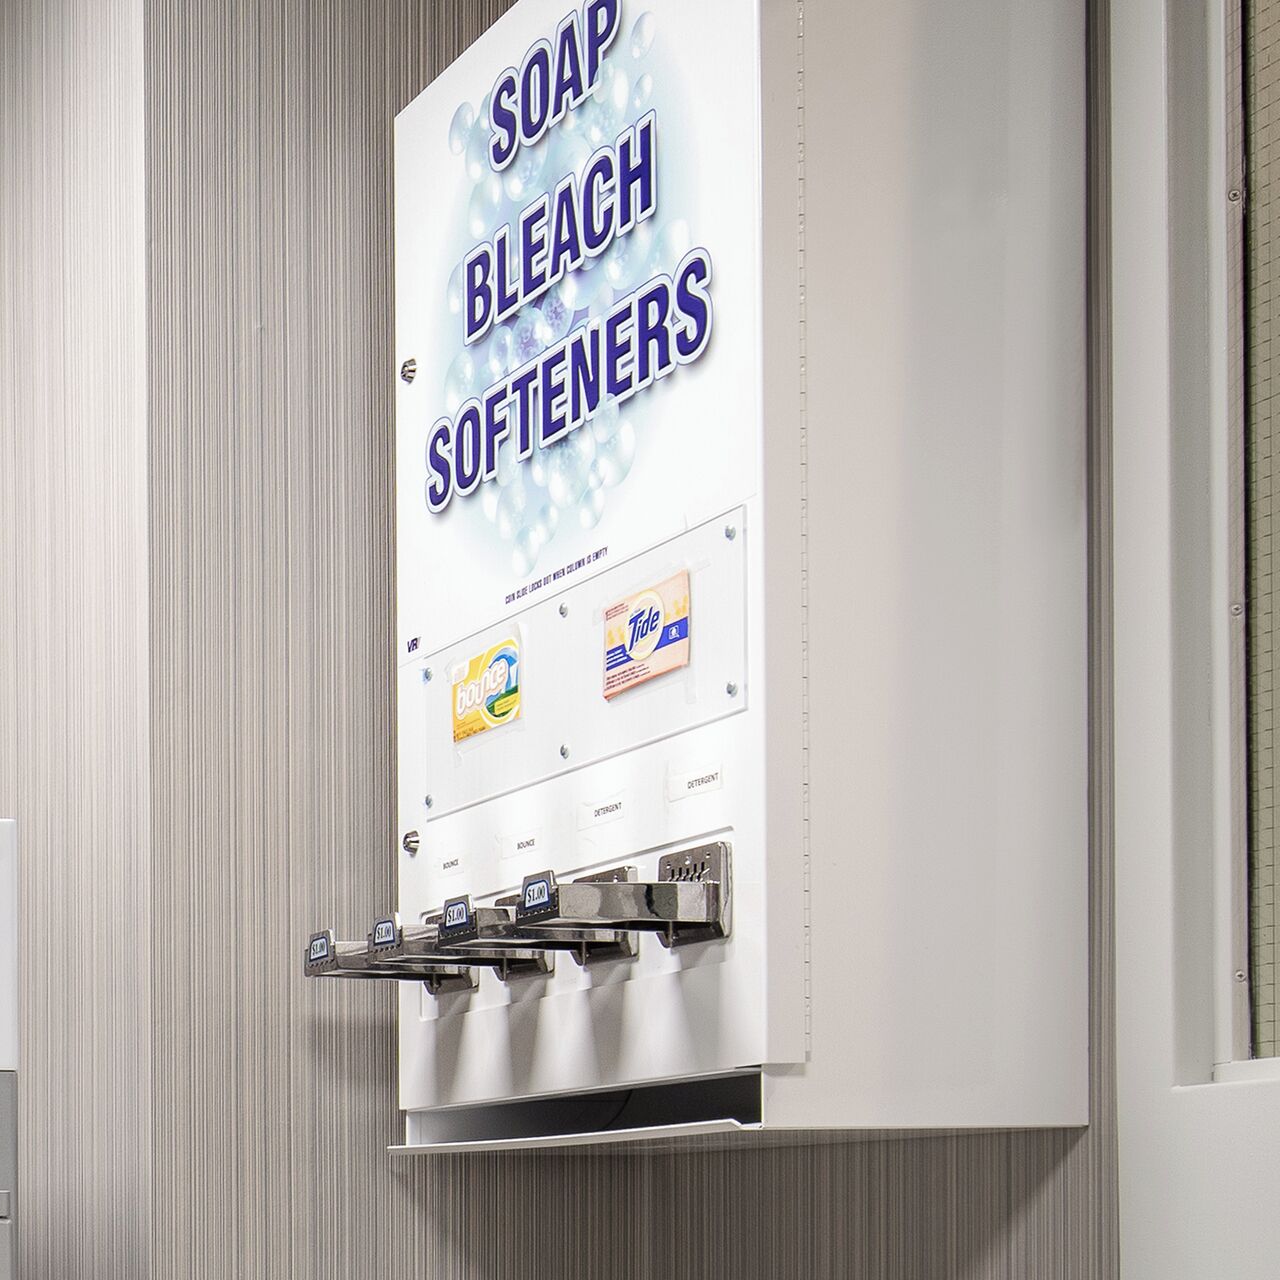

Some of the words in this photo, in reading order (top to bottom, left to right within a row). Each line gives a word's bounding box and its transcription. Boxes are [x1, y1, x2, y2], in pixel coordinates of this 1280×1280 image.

[491, 0, 621, 170] SOAP
[464, 112, 655, 344] BLEACH
[426, 248, 712, 512] SOFTENERS
[628, 606, 661, 652] Tide
[687, 772, 719, 789] DETERGENT
[593, 801, 622, 818] DETERGENT
[526, 884, 546, 903] $1.00
[447, 906, 465, 923] $1.00
